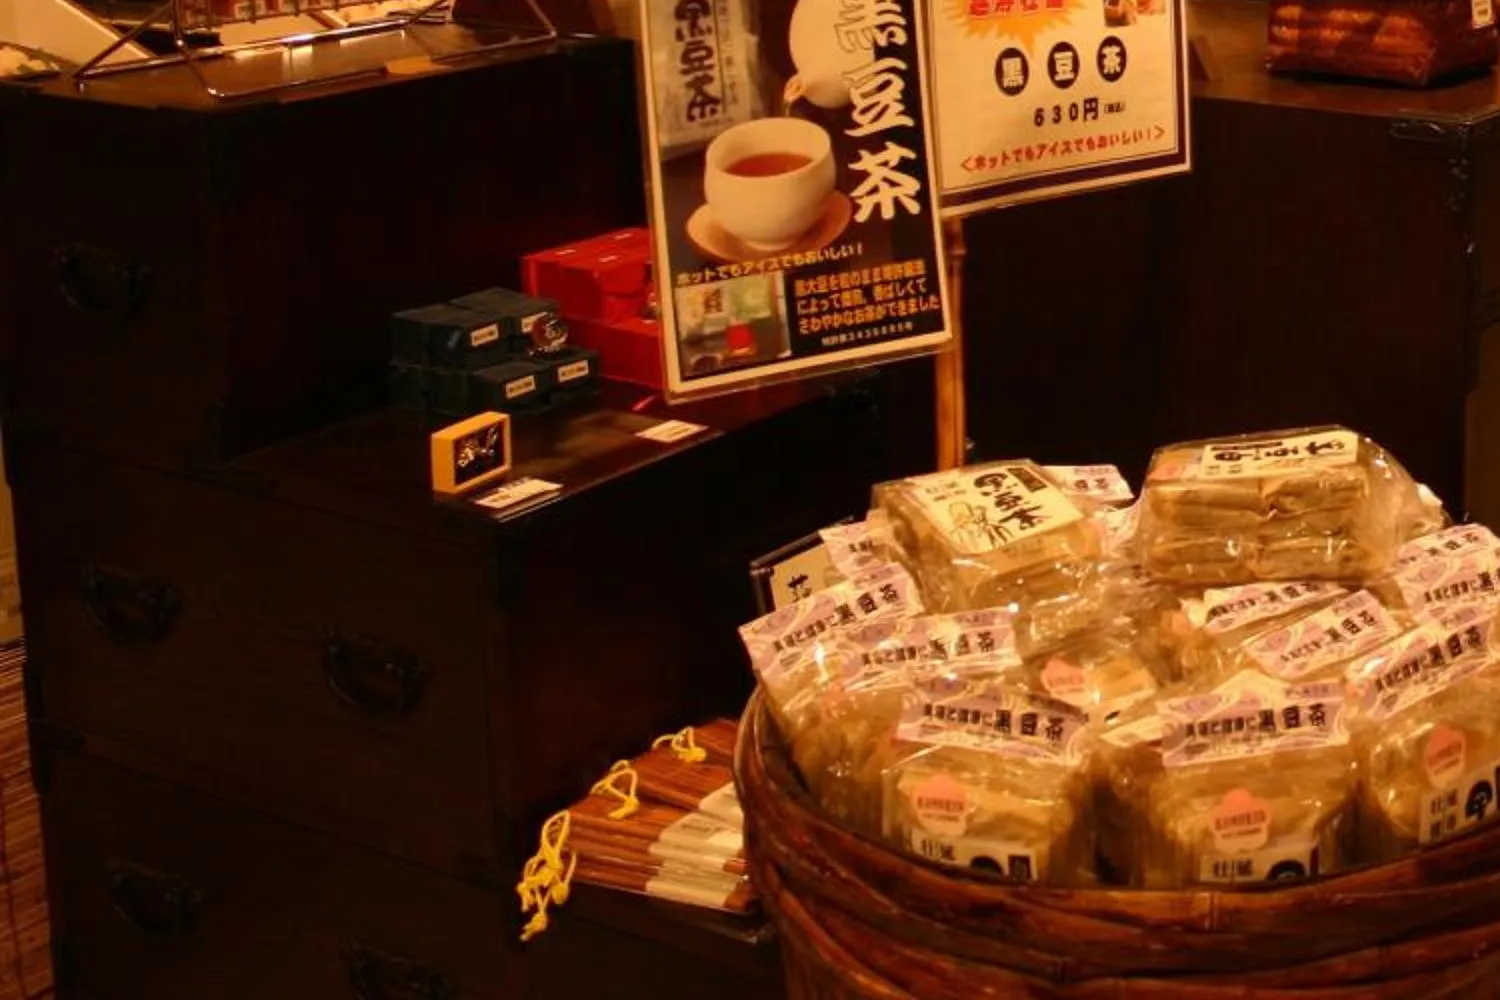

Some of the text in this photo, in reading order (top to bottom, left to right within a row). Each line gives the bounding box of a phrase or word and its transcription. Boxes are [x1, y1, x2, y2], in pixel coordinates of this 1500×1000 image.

[998, 42, 1124, 91] 黒豆茶
[1033, 96, 1100, 128] 630円
